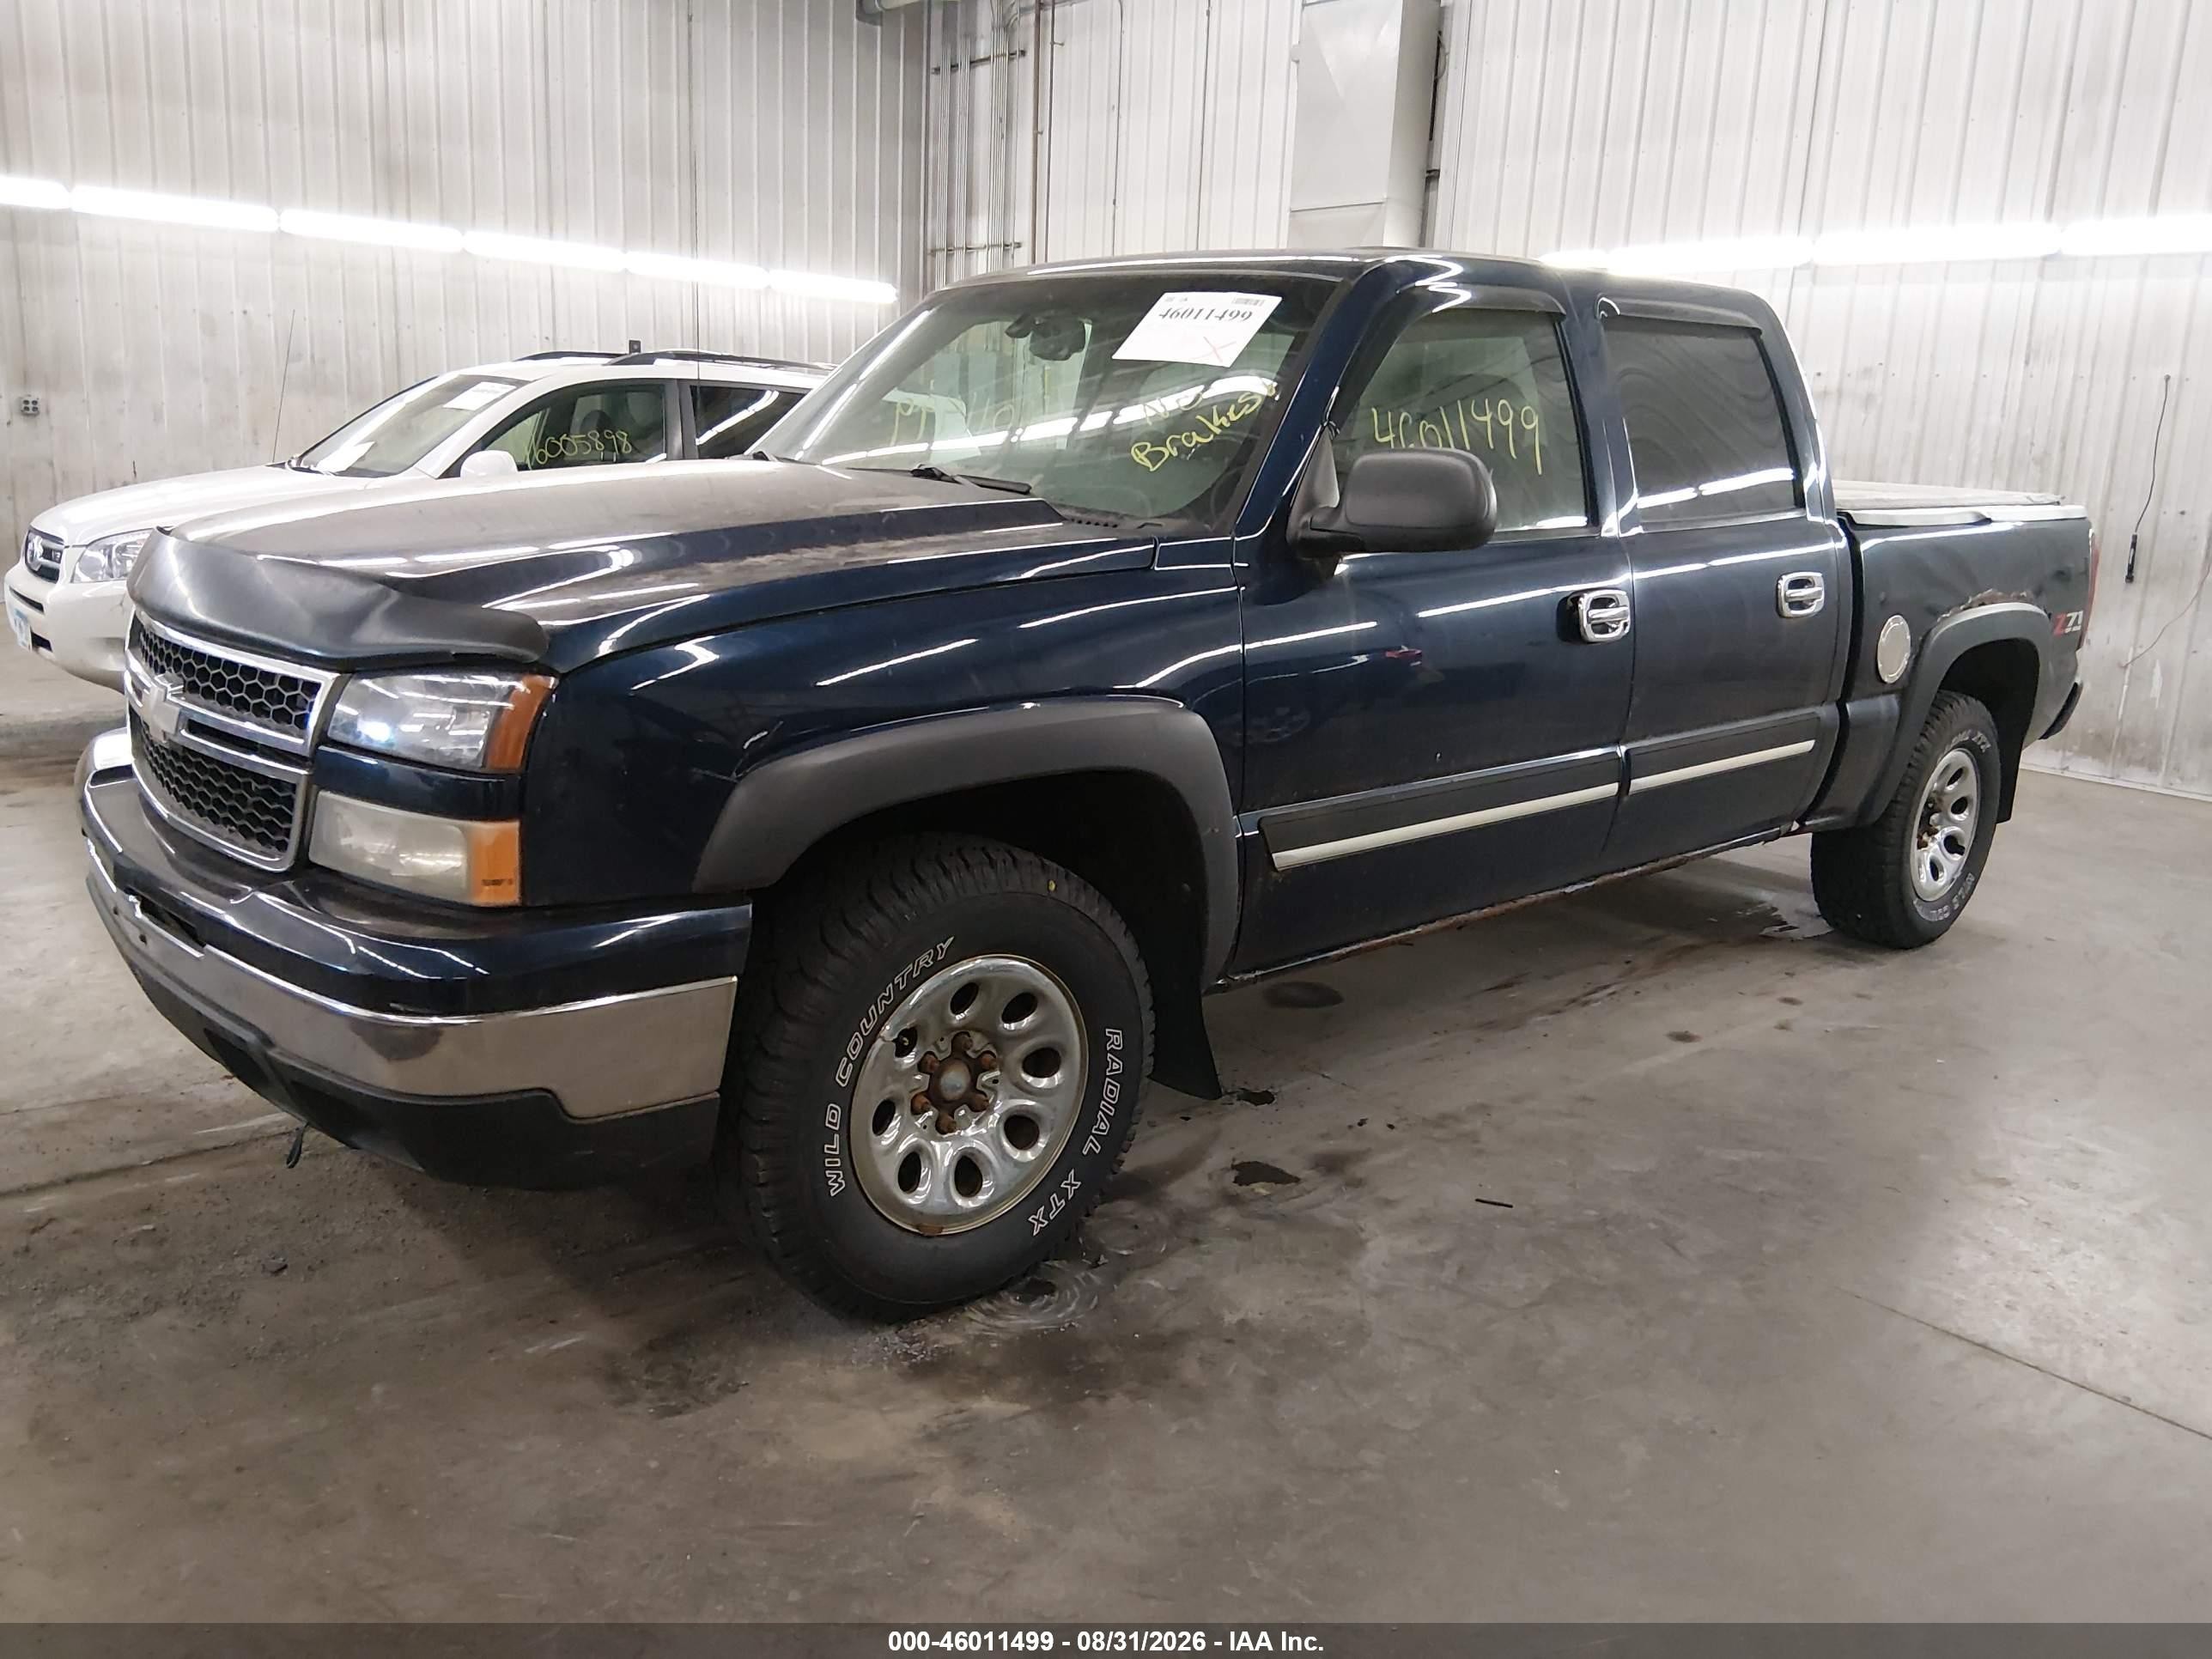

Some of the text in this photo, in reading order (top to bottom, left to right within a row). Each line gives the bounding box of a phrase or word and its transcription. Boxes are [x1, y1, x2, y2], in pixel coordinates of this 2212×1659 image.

[1158, 307, 1254, 322] 46011499
[822, 935, 955, 1197] WILD COUNTRY
[1028, 1027, 1124, 1237] RADIAL XTX
